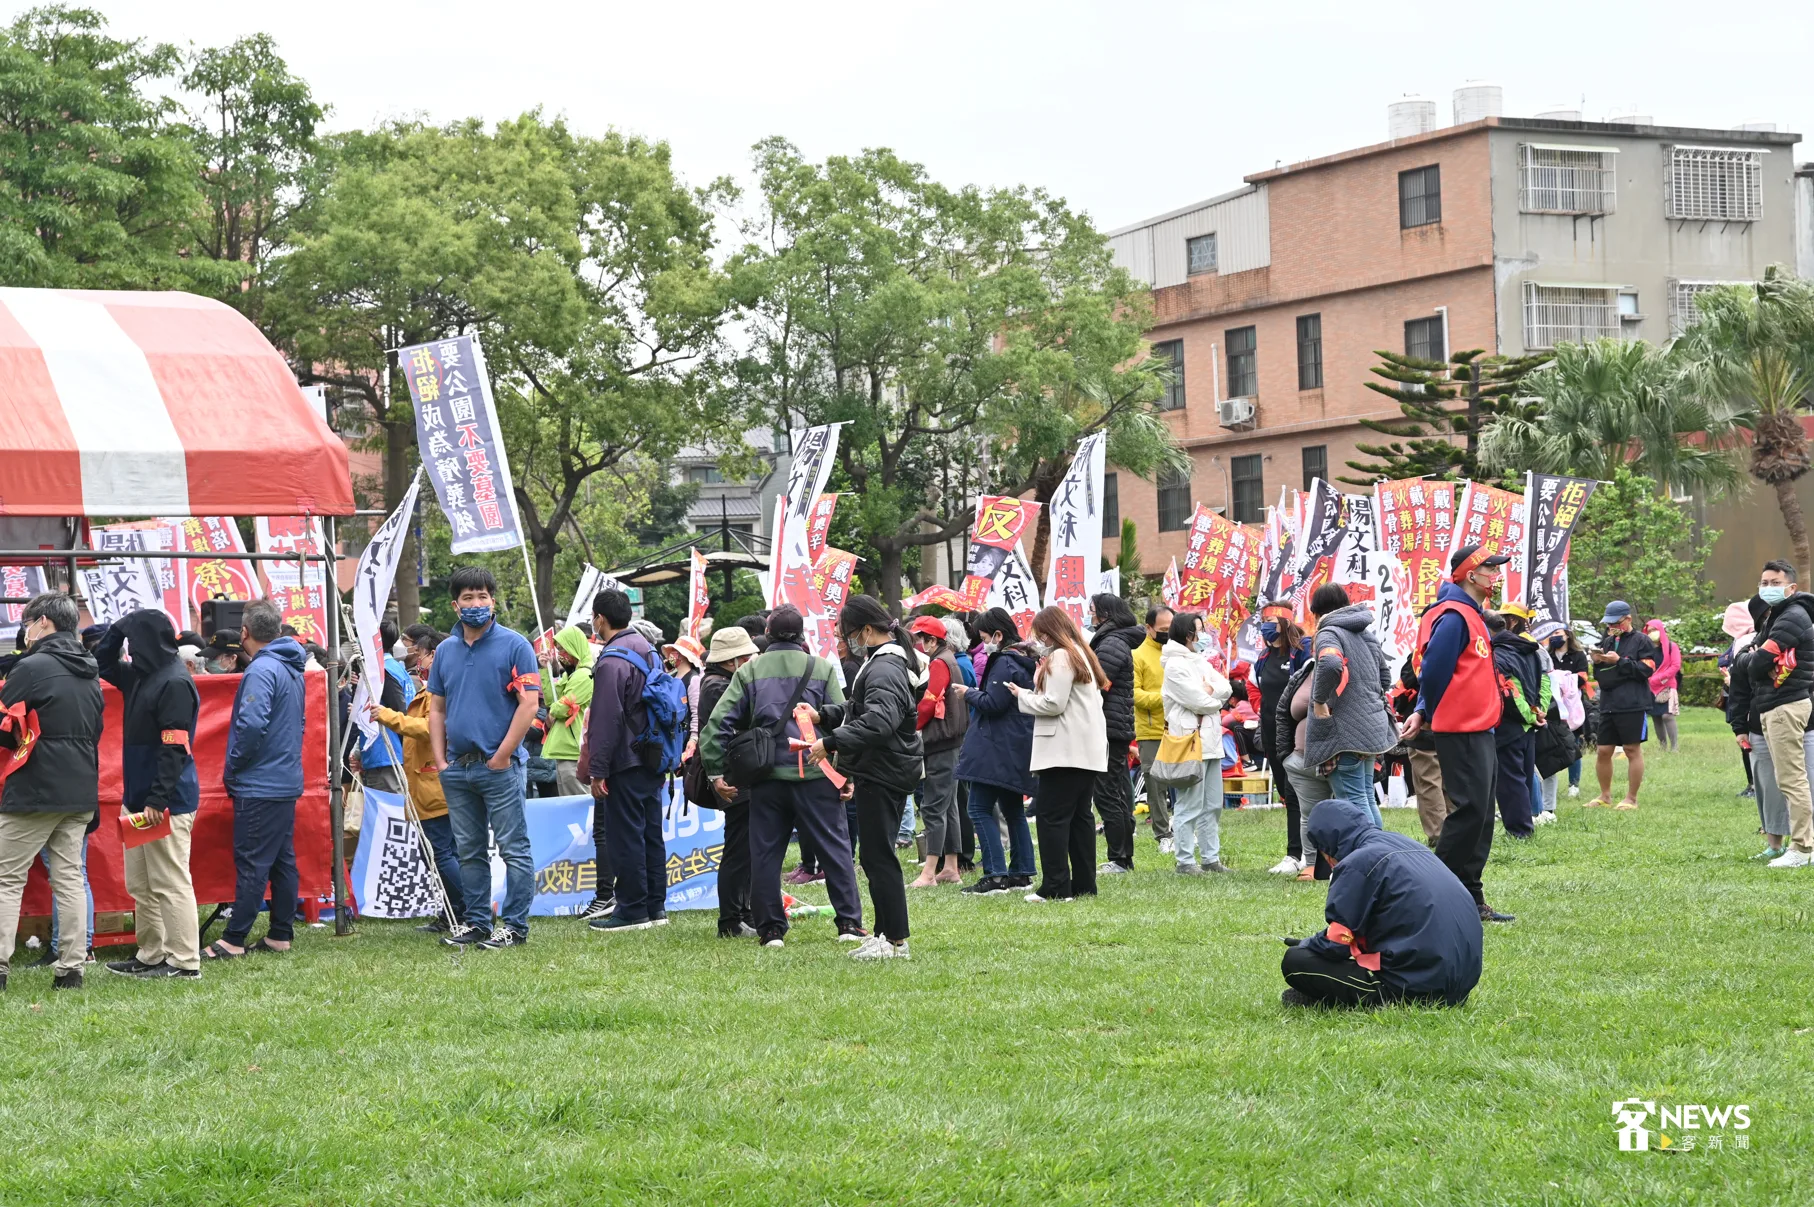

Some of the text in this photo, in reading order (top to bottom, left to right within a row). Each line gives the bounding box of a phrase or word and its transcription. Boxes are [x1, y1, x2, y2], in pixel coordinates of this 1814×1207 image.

[808, 499, 833, 551] 戴奧辛
[974, 498, 1022, 541] 反
[1184, 514, 1213, 570] 靈骨塔
[1344, 498, 1372, 582] 楊文科
[1382, 490, 1401, 553] 靈骨塔
[1395, 489, 1415, 552] 火葬場
[1433, 489, 1451, 552] 戴奧辛
[1199, 522, 1230, 575] 火葬場
[1219, 530, 1246, 579] 戴奧辛
